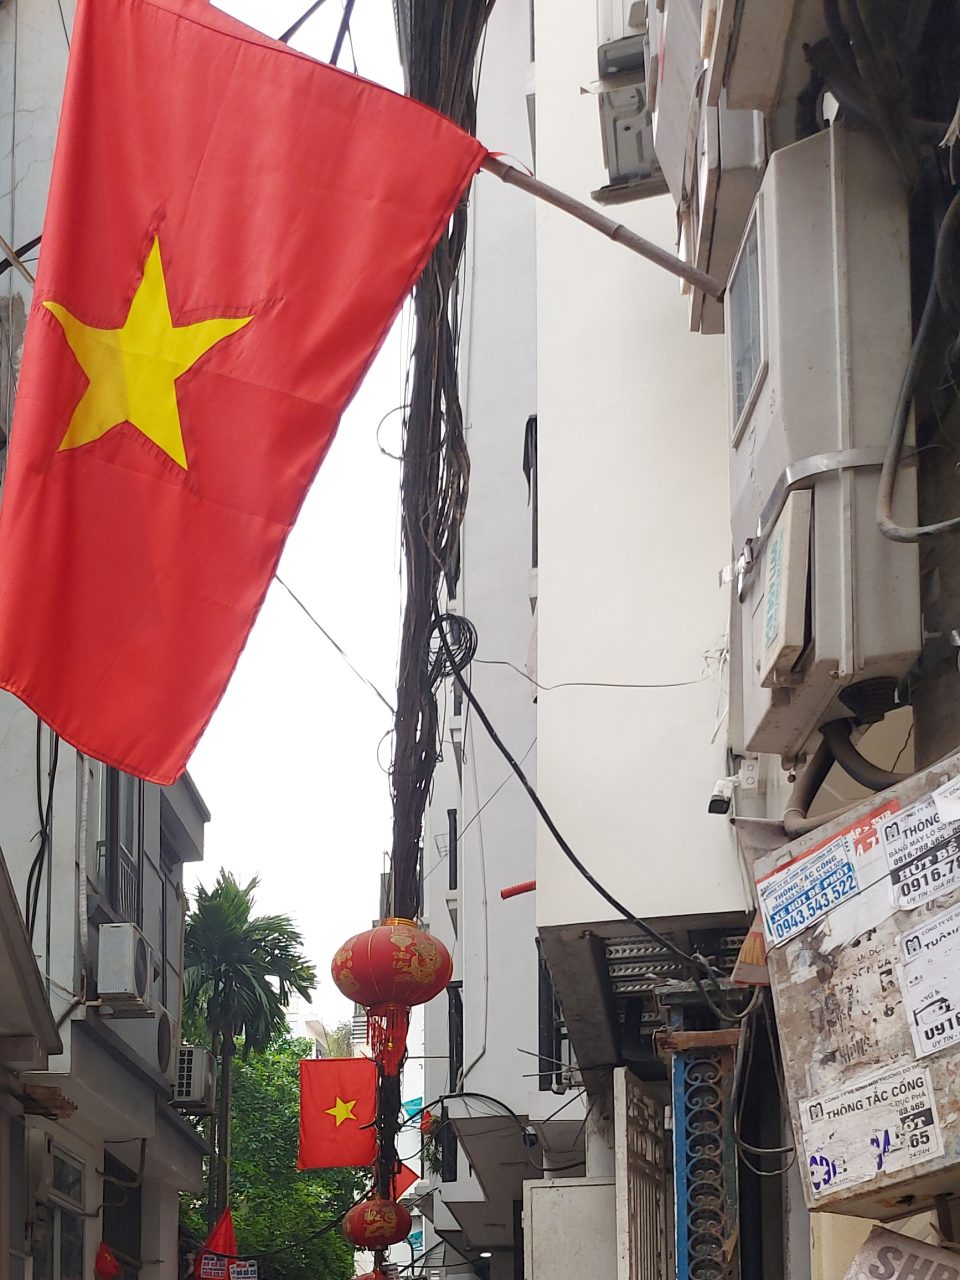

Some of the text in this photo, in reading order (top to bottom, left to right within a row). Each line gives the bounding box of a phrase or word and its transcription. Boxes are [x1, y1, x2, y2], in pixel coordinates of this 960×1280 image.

[902, 812, 940, 841] THÔNG
[776, 874, 856, 939] 0943.543.522
[826, 1077, 924, 1120] THÔNG TẮC CỐNG
